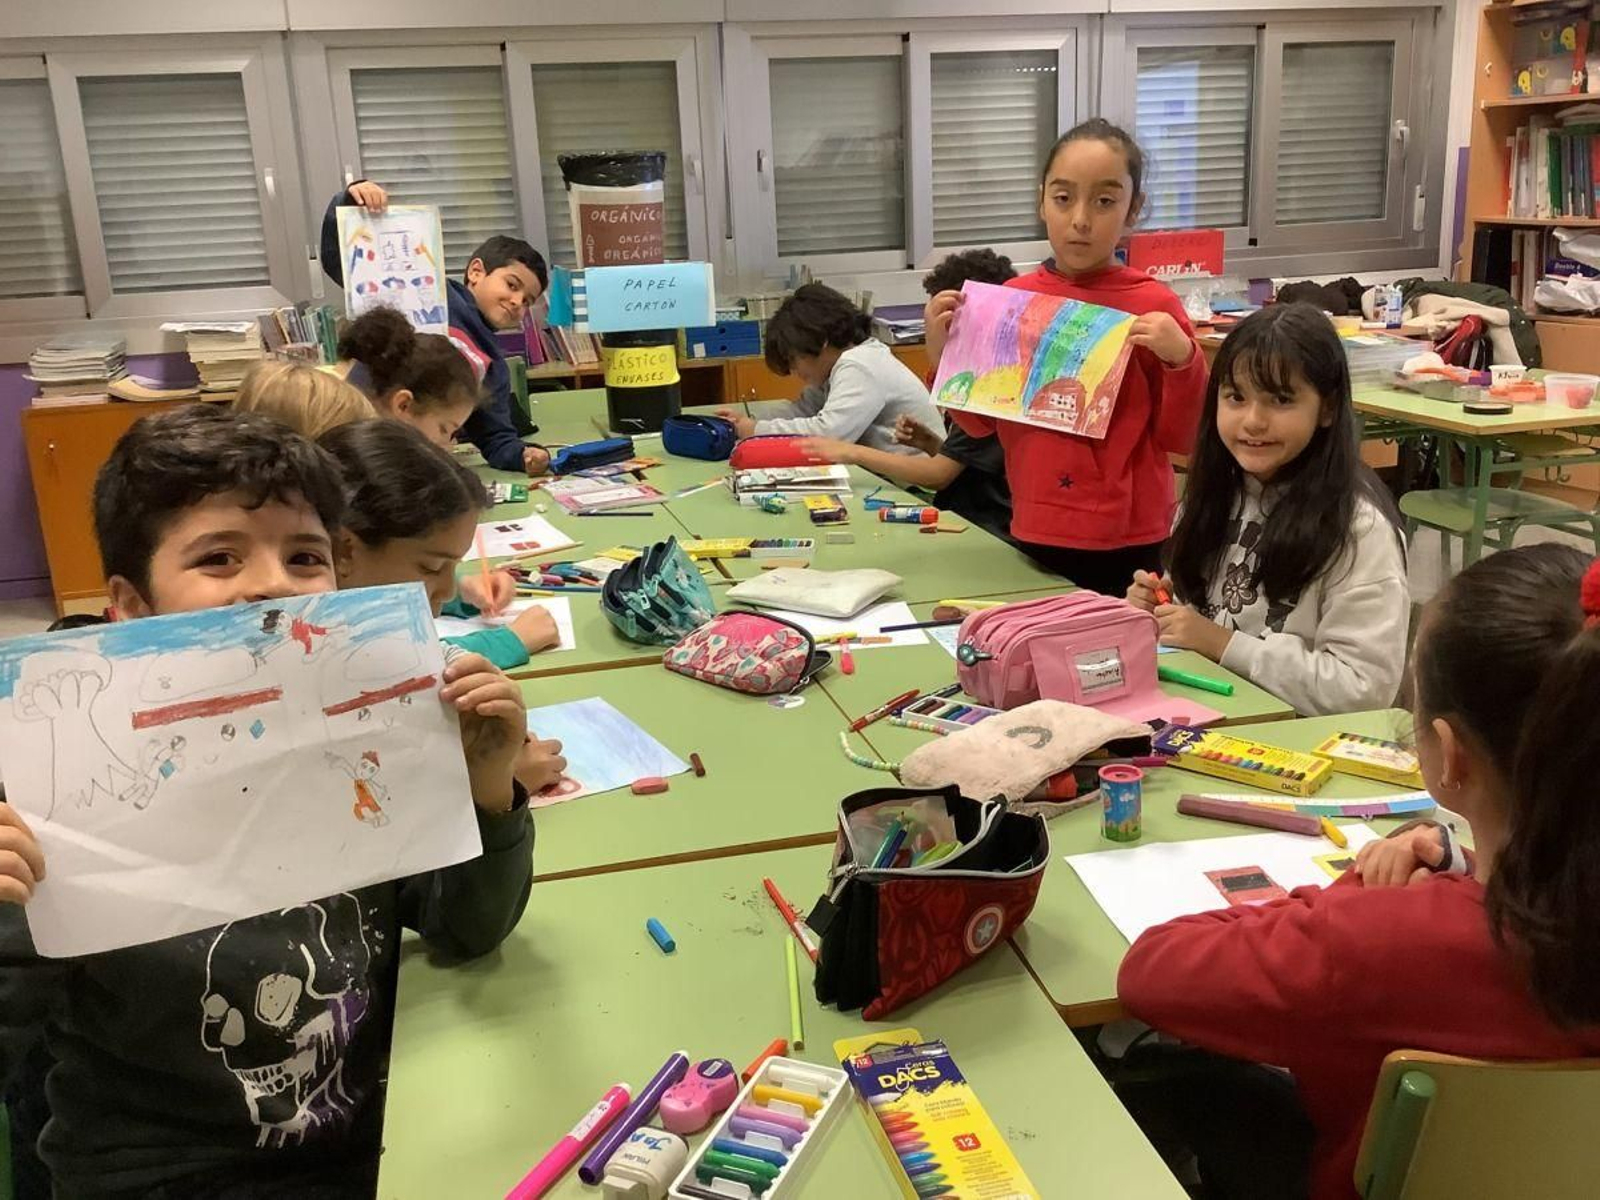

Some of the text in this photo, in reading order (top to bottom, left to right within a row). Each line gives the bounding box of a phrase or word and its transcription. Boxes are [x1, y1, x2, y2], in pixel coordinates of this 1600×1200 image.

[623, 276, 676, 291] PAPEL
[877, 1065, 941, 1089] DACS
[958, 1136, 977, 1149] 12
